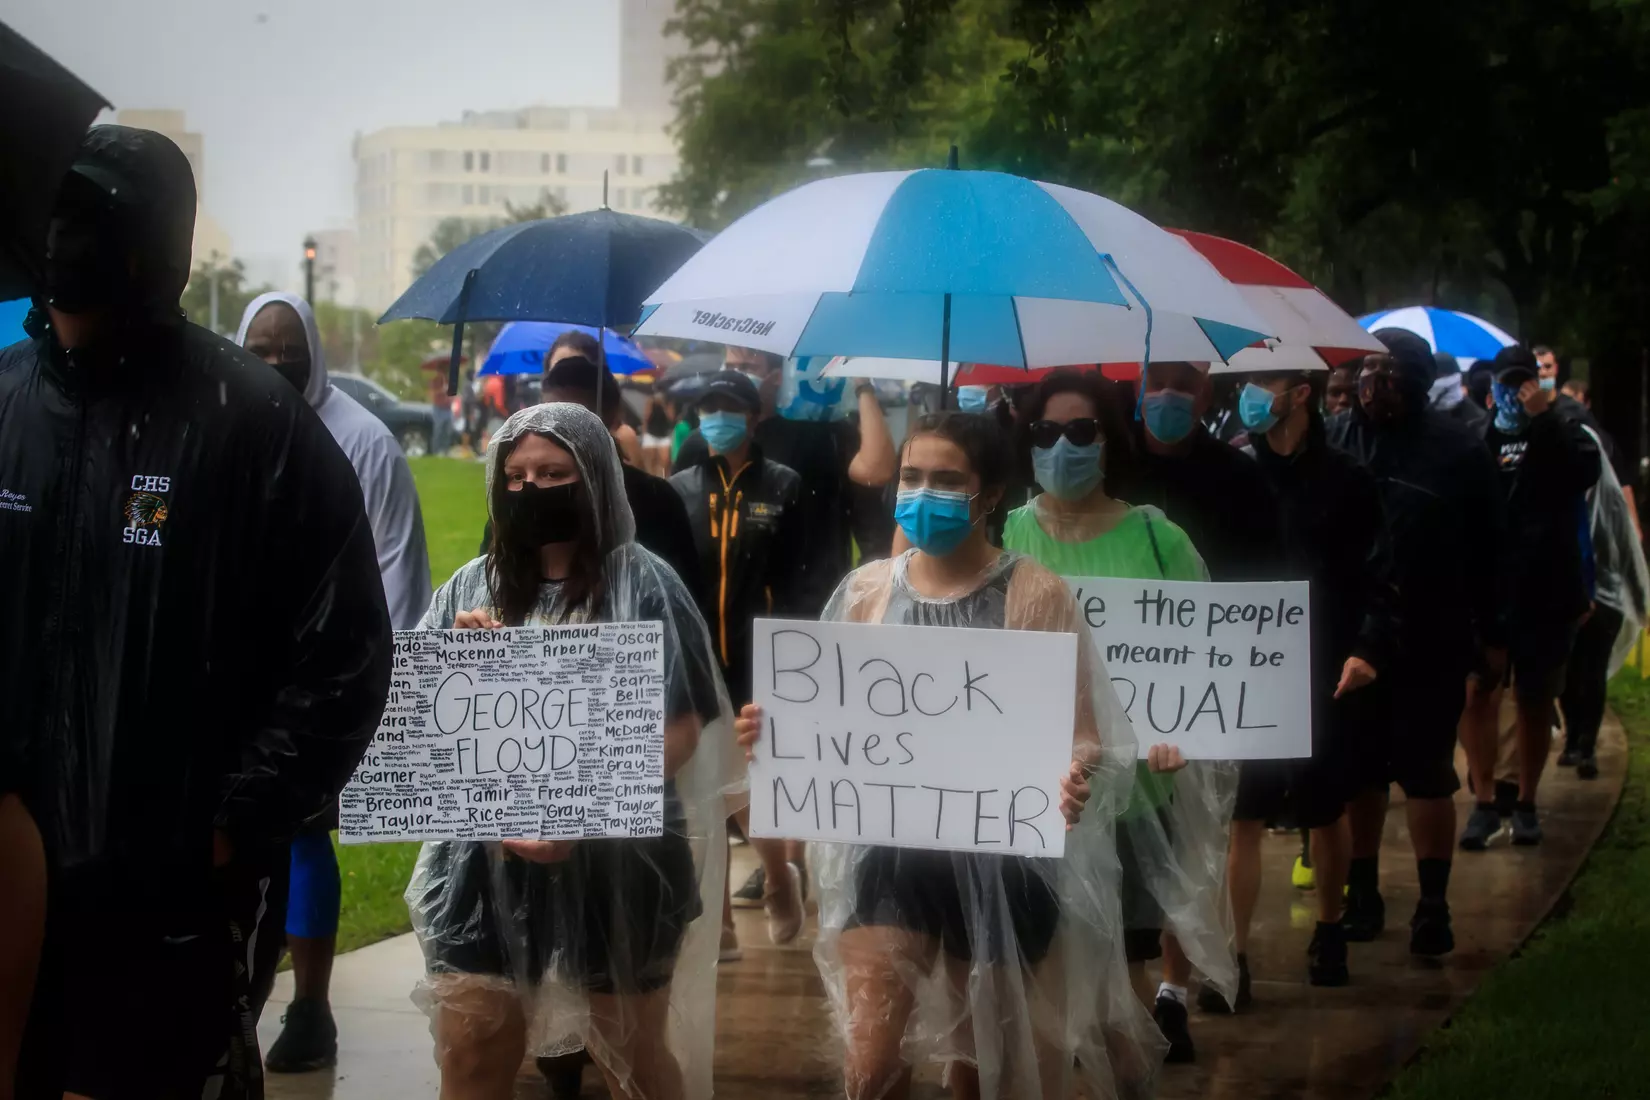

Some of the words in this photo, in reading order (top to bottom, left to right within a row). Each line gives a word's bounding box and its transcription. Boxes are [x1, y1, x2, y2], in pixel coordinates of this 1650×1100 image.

[131, 475, 171, 492] CHS
[0, 489, 26, 500] Reyes
[13, 503, 32, 513] Service
[123, 527, 162, 546] SGA
[1077, 588, 1106, 628] e
[1134, 589, 1195, 628] the
[1206, 598, 1304, 637] people
[443, 630, 512, 645] Natasha
[543, 626, 599, 641] Ahmaud
[393, 640, 421, 655] ndo
[543, 644, 596, 659] Arbery
[437, 648, 505, 664] McKenna
[615, 648, 659, 664] Grant
[1107, 643, 1196, 665] meant
[1205, 645, 1233, 668] to
[1250, 646, 1284, 667] be
[771, 629, 1003, 717] Black
[391, 680, 411, 689] an
[616, 688, 644, 702] Bell
[434, 672, 586, 735] GEORGE
[382, 715, 407, 727] dra
[606, 707, 662, 722] Kendrec
[373, 730, 404, 743] and
[605, 723, 657, 737] McDade
[770, 716, 914, 766] Lives
[457, 735, 577, 775] FLOYD
[600, 744, 646, 757] Kimani
[361, 753, 380, 767] ric
[607, 760, 645, 772] Gray
[360, 771, 416, 784] Garner
[461, 788, 512, 803] Tamir
[538, 785, 597, 800] Freddie
[366, 796, 432, 812] Breonna
[614, 800, 658, 814] Taylor
[465, 807, 503, 822] Rice
[547, 804, 585, 820] Gray
[773, 776, 1049, 849] MATTER
[377, 813, 433, 830] Taylor
[601, 817, 652, 829] Trayvon
[630, 826, 662, 836] Martin
